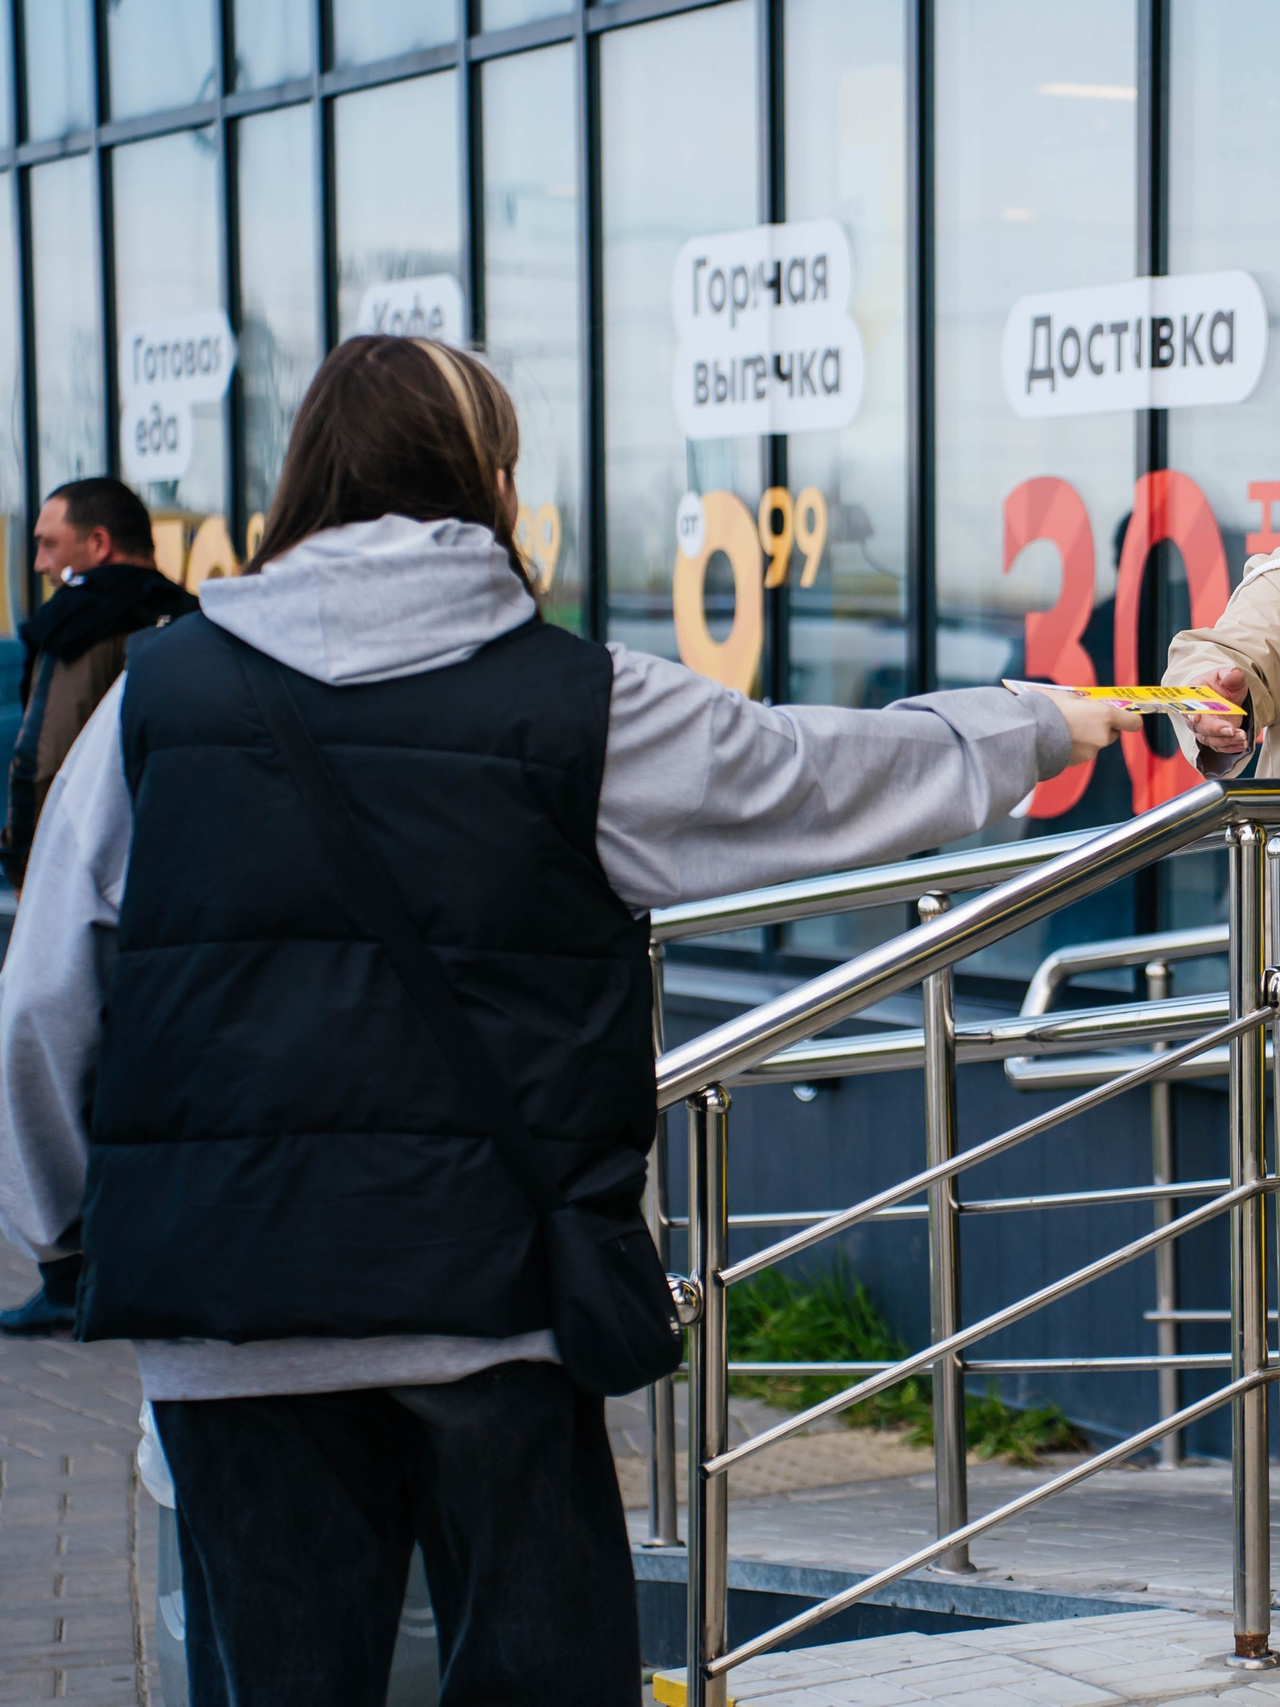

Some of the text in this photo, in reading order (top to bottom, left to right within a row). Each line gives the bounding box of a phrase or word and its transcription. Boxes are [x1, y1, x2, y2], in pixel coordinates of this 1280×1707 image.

[692, 254, 828, 329] Горчая
[135, 402, 179, 457] еда
[1002, 469, 1231, 819] 30
